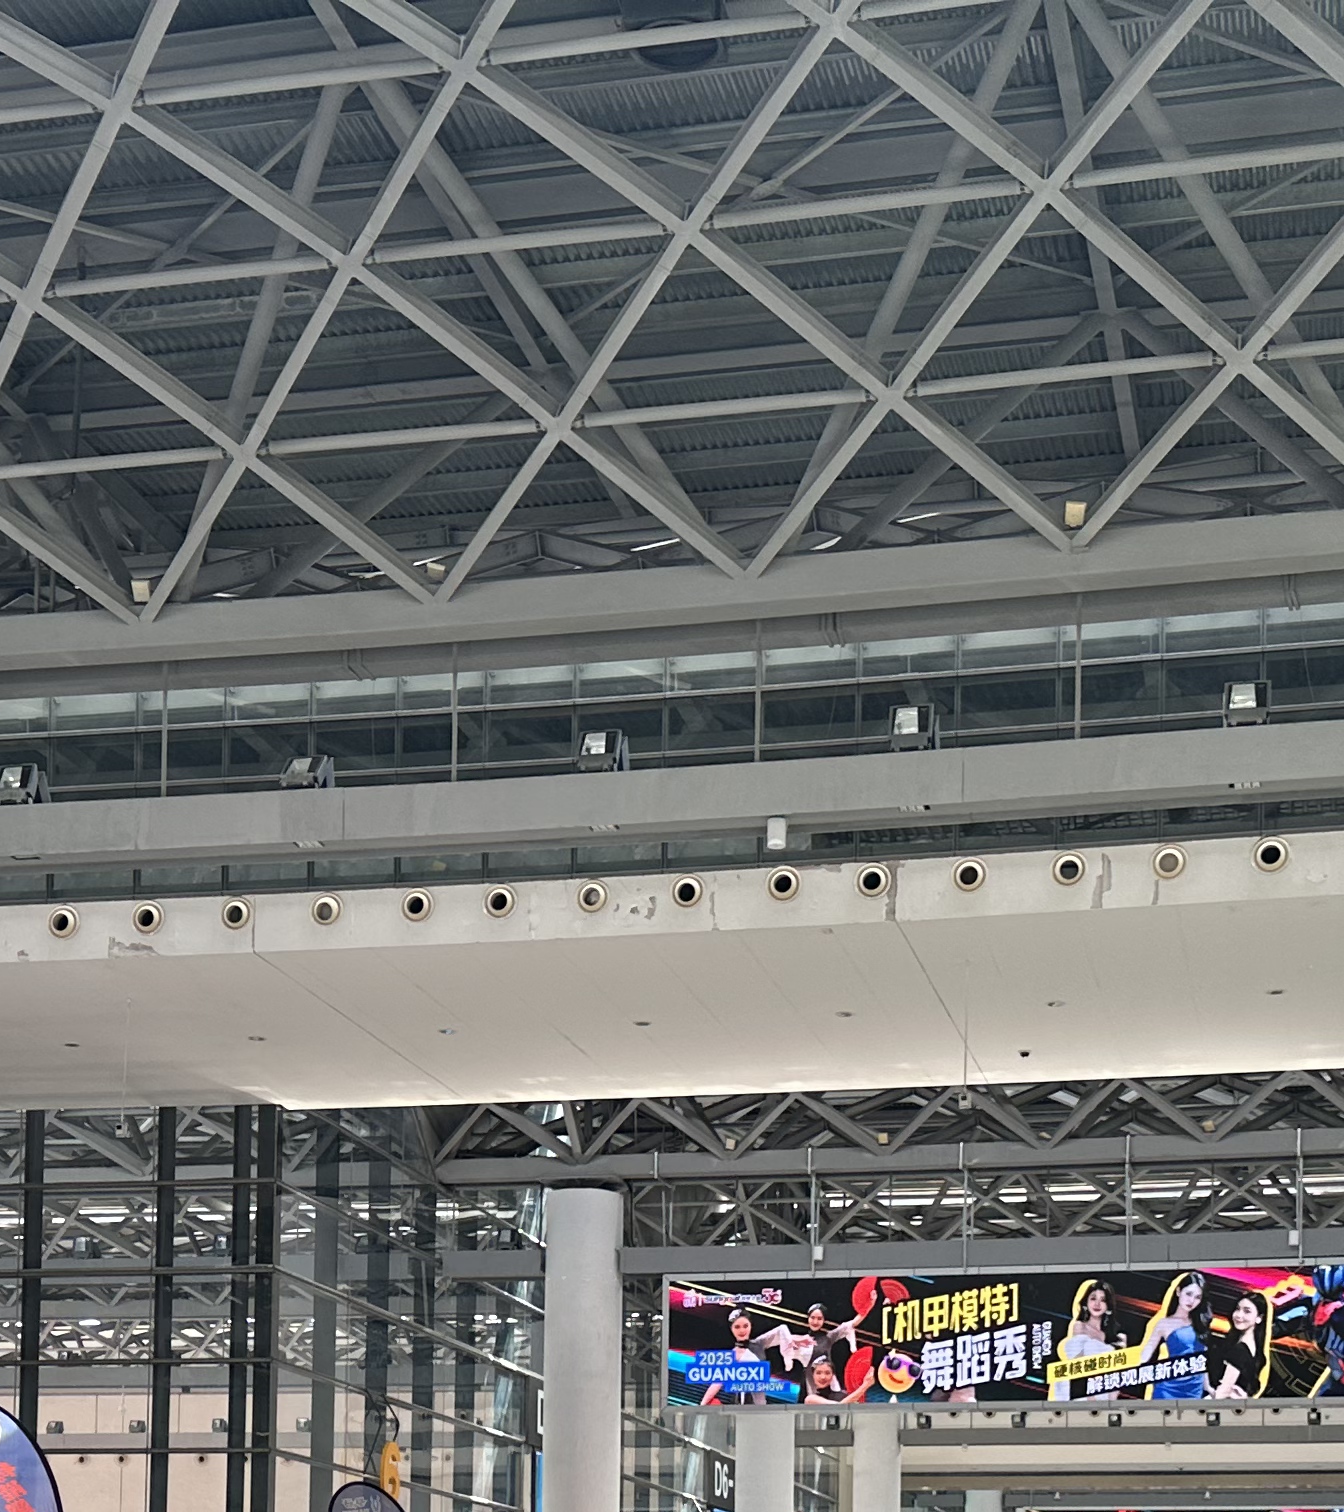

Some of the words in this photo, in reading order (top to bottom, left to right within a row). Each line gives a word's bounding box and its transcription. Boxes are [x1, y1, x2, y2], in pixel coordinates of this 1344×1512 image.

[699, 1351, 733, 1365] 2025
[920, 1325, 1028, 1393] 舞蹈秀
[1053, 1352, 1128, 1379] 硬核碰时尚
[688, 1365, 765, 1382] GUANGXI
[1086, 1355, 1208, 1394] 解锁观展新体验
[730, 1382, 755, 1392] AUTO
[756, 1381, 785, 1392] SHOW
